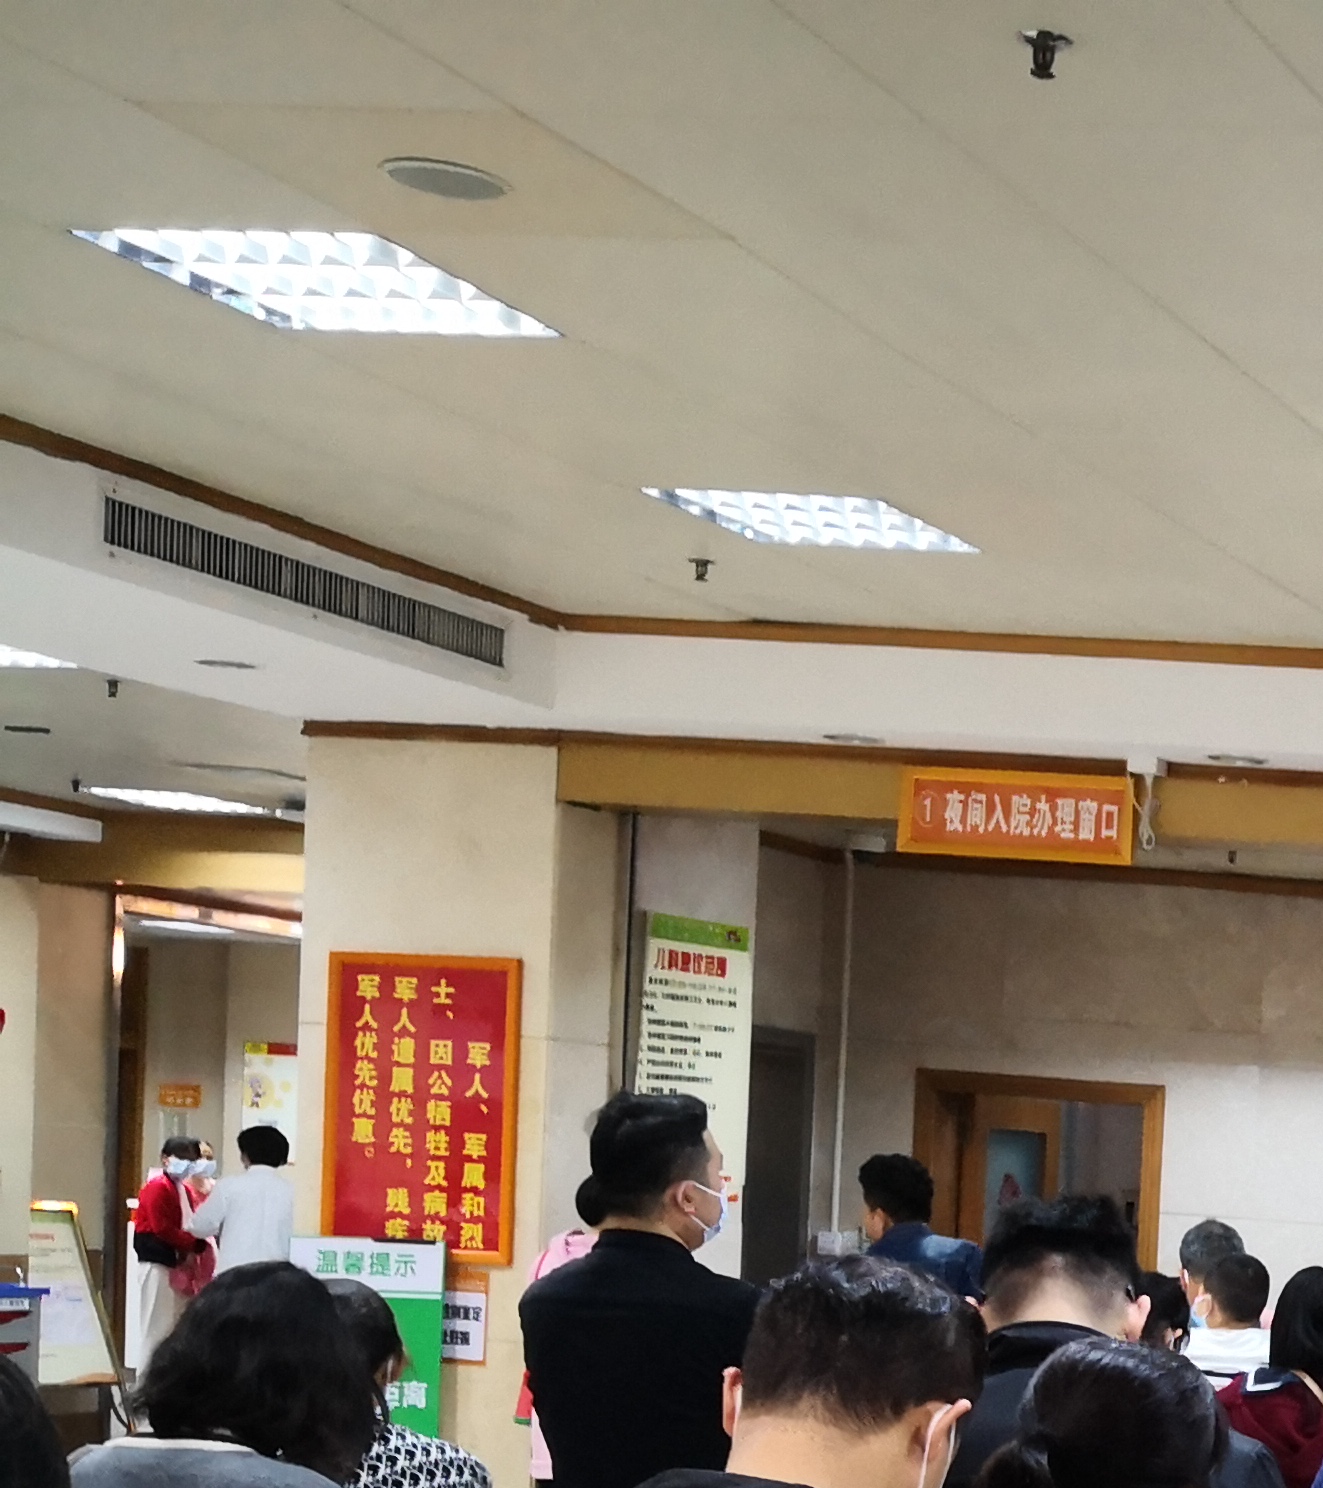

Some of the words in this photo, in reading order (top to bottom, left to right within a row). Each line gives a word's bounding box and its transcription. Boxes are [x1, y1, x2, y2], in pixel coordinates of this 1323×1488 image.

[944, 789, 1120, 841] 夜间入院办理窗口
[315, 1249, 417, 1278] 温馨提示
